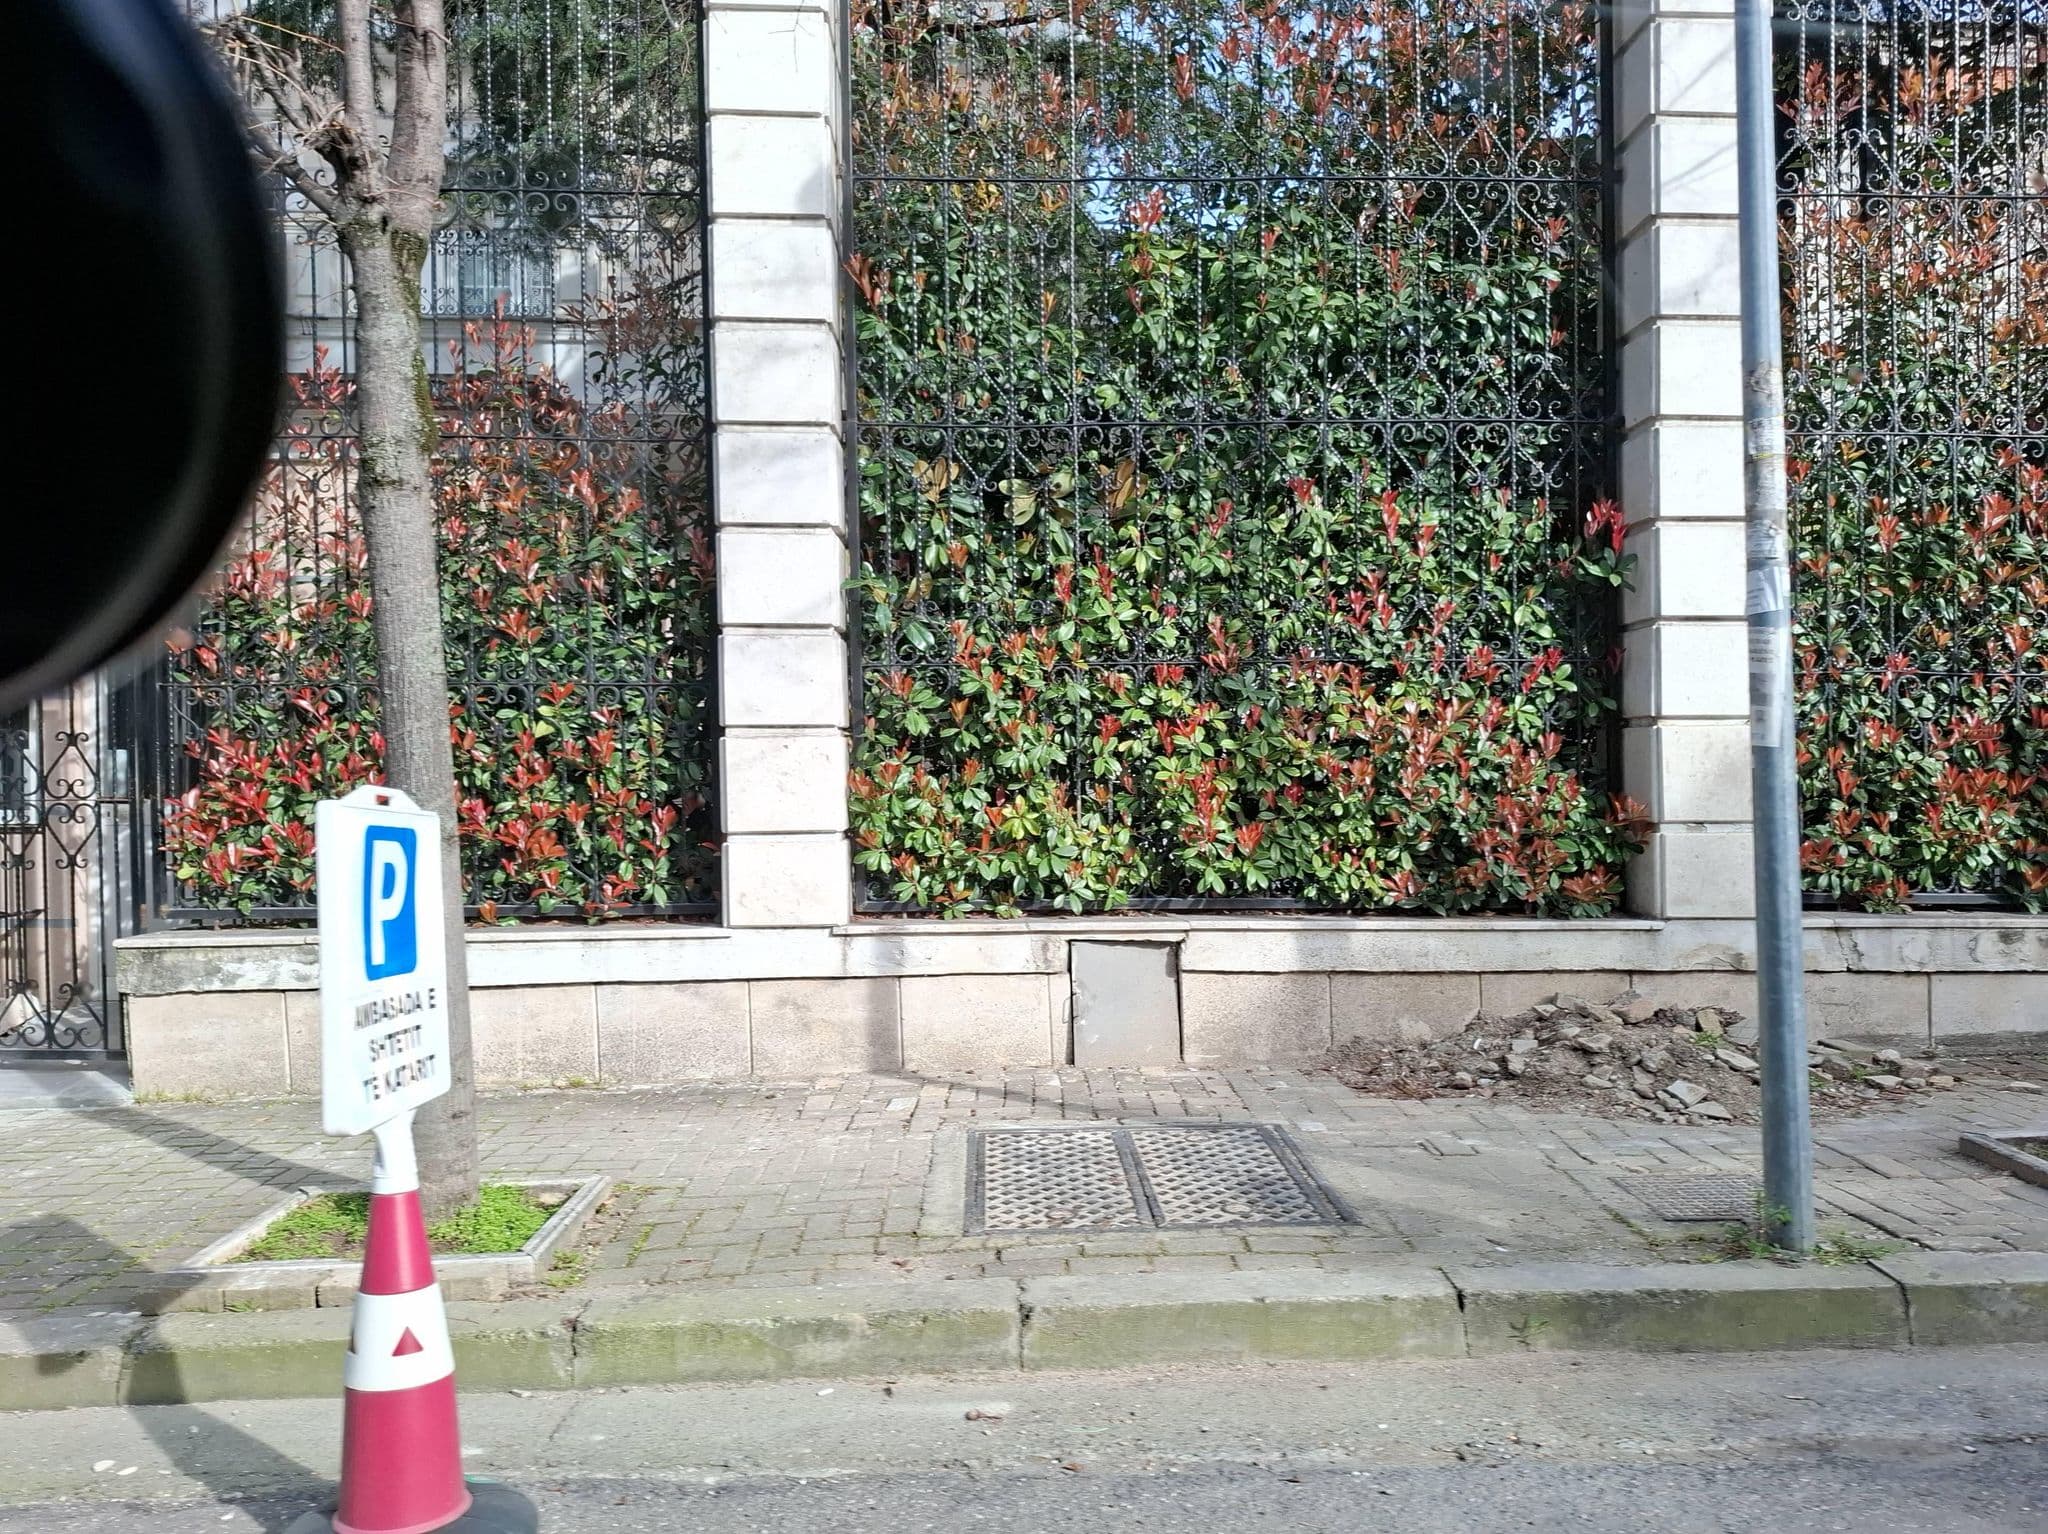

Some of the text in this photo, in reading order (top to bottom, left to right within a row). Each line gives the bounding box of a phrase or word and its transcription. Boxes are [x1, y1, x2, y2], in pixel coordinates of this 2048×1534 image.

[371, 840, 408, 965] P
[355, 987, 436, 1030] AMBASADA E
